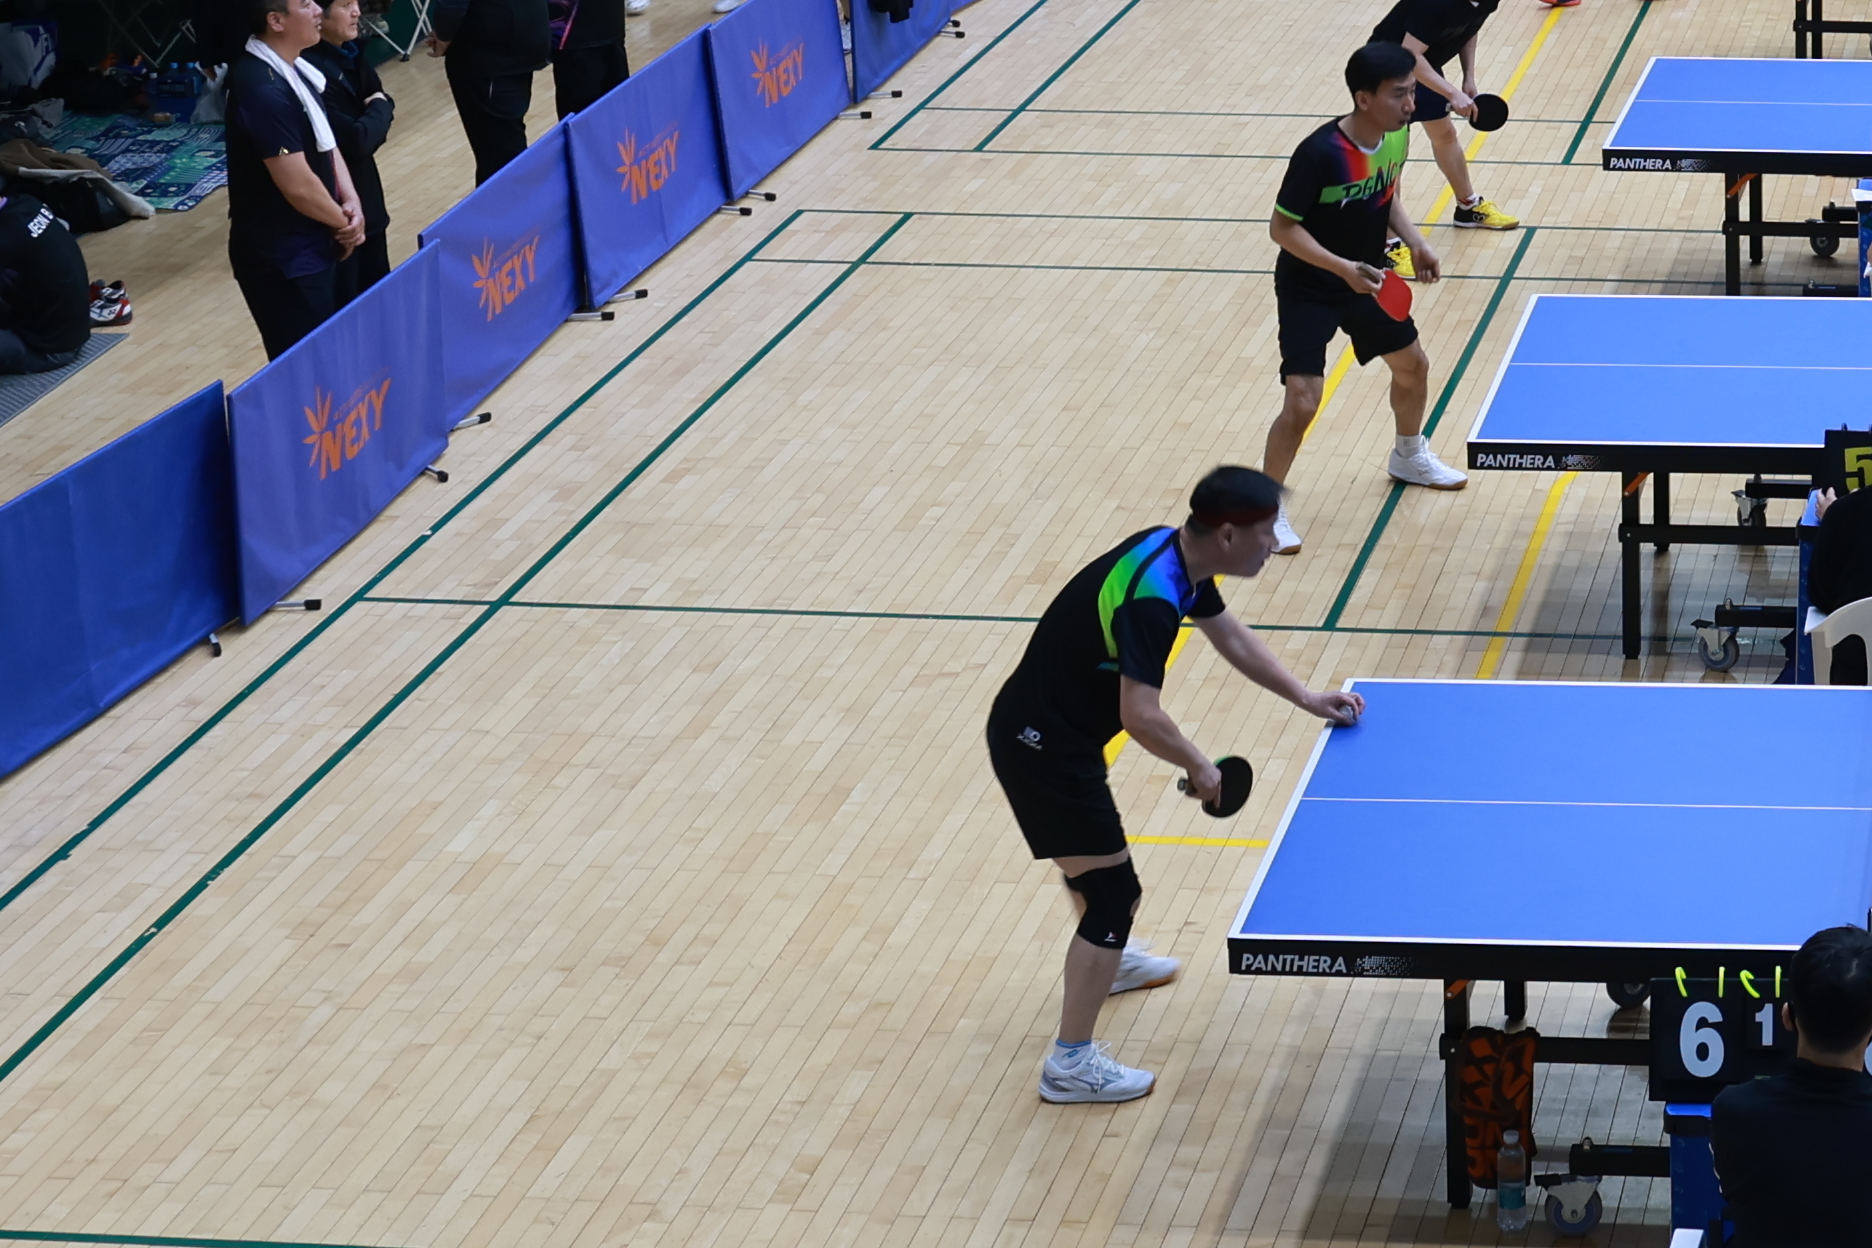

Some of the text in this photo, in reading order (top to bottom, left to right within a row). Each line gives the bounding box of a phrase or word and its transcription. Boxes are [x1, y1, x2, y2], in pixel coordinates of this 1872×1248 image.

[764, 42, 805, 109] NEXY
[630, 131, 680, 205] NEXY
[1609, 156, 1674, 172] PANTHERA
[486, 234, 540, 322] NEXY
[319, 377, 393, 480] NEXY
[1475, 452, 1556, 470] PANTHERA
[1239, 953, 1348, 975] PANTHERA
[1678, 1001, 1726, 1078] 6
[1754, 1003, 1774, 1047] 1
